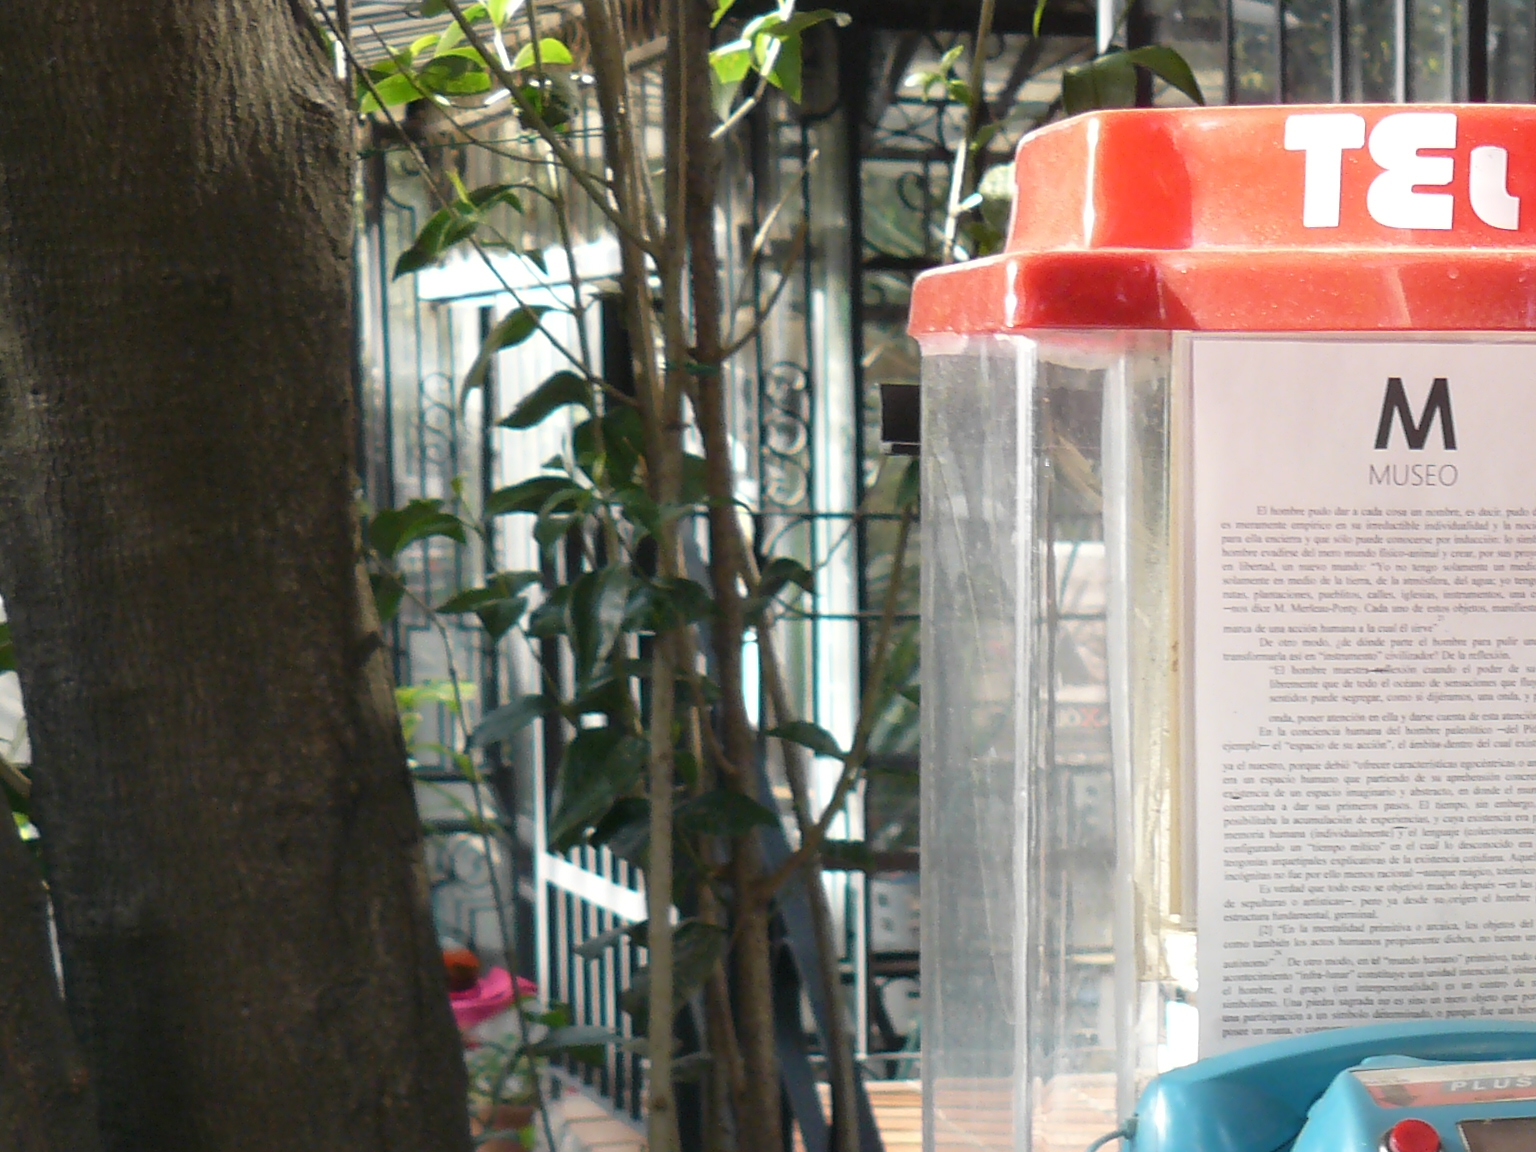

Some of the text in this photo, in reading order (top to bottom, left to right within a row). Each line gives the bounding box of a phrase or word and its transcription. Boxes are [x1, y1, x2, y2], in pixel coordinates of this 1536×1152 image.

[1374, 377, 1457, 450] M
[1369, 463, 1458, 486] MUSEO
[1450, 1076, 1533, 1092] PLUS
